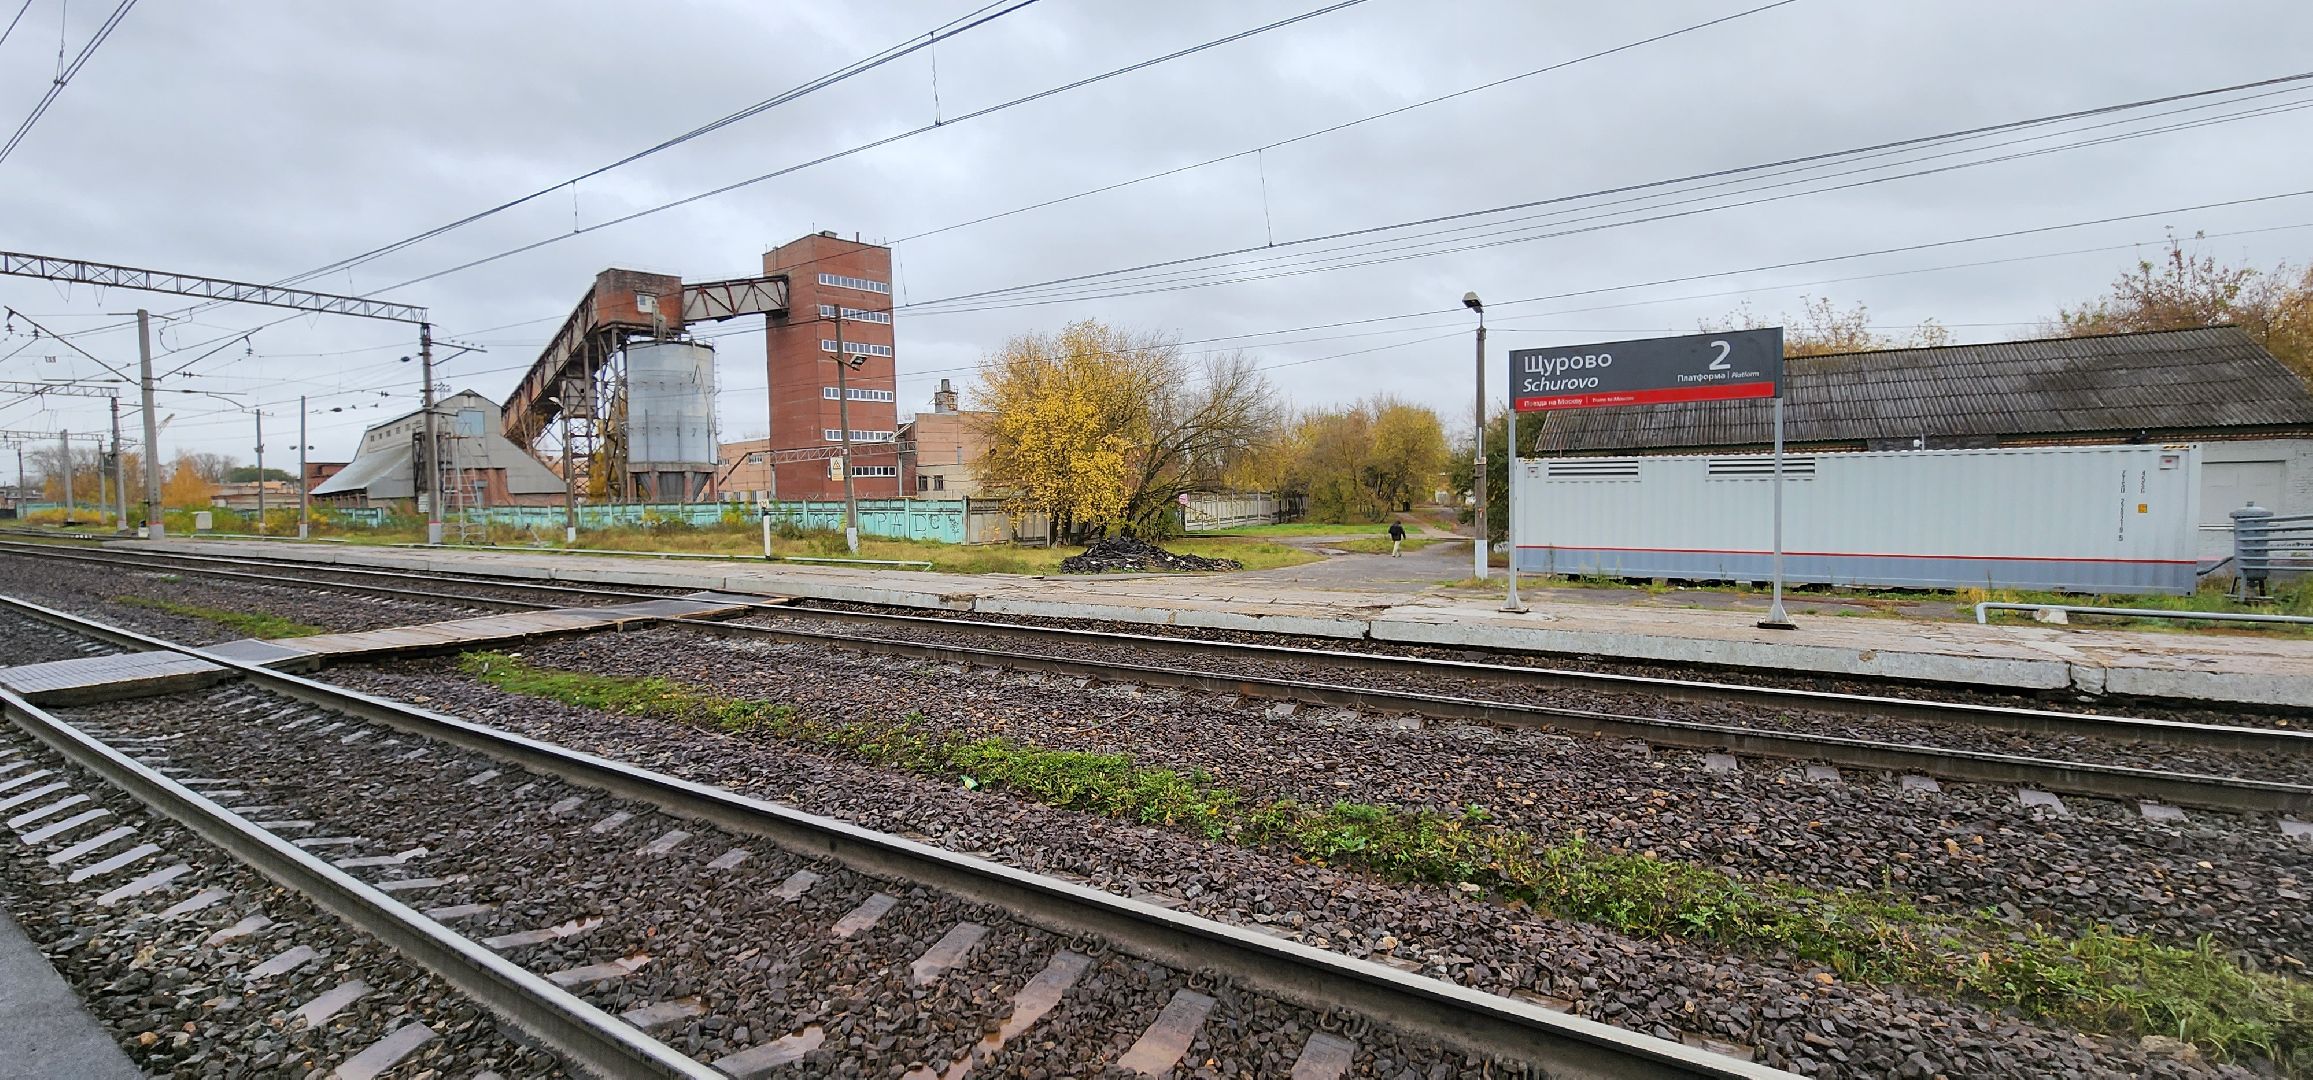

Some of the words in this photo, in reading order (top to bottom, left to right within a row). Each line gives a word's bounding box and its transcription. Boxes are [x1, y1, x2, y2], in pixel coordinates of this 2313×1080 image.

[1524, 354, 1612, 376] Щурово
[1708, 340, 1731, 371] 2
[1523, 376, 1599, 392] Schurovo
[1677, 372, 1726, 382] Платформа
